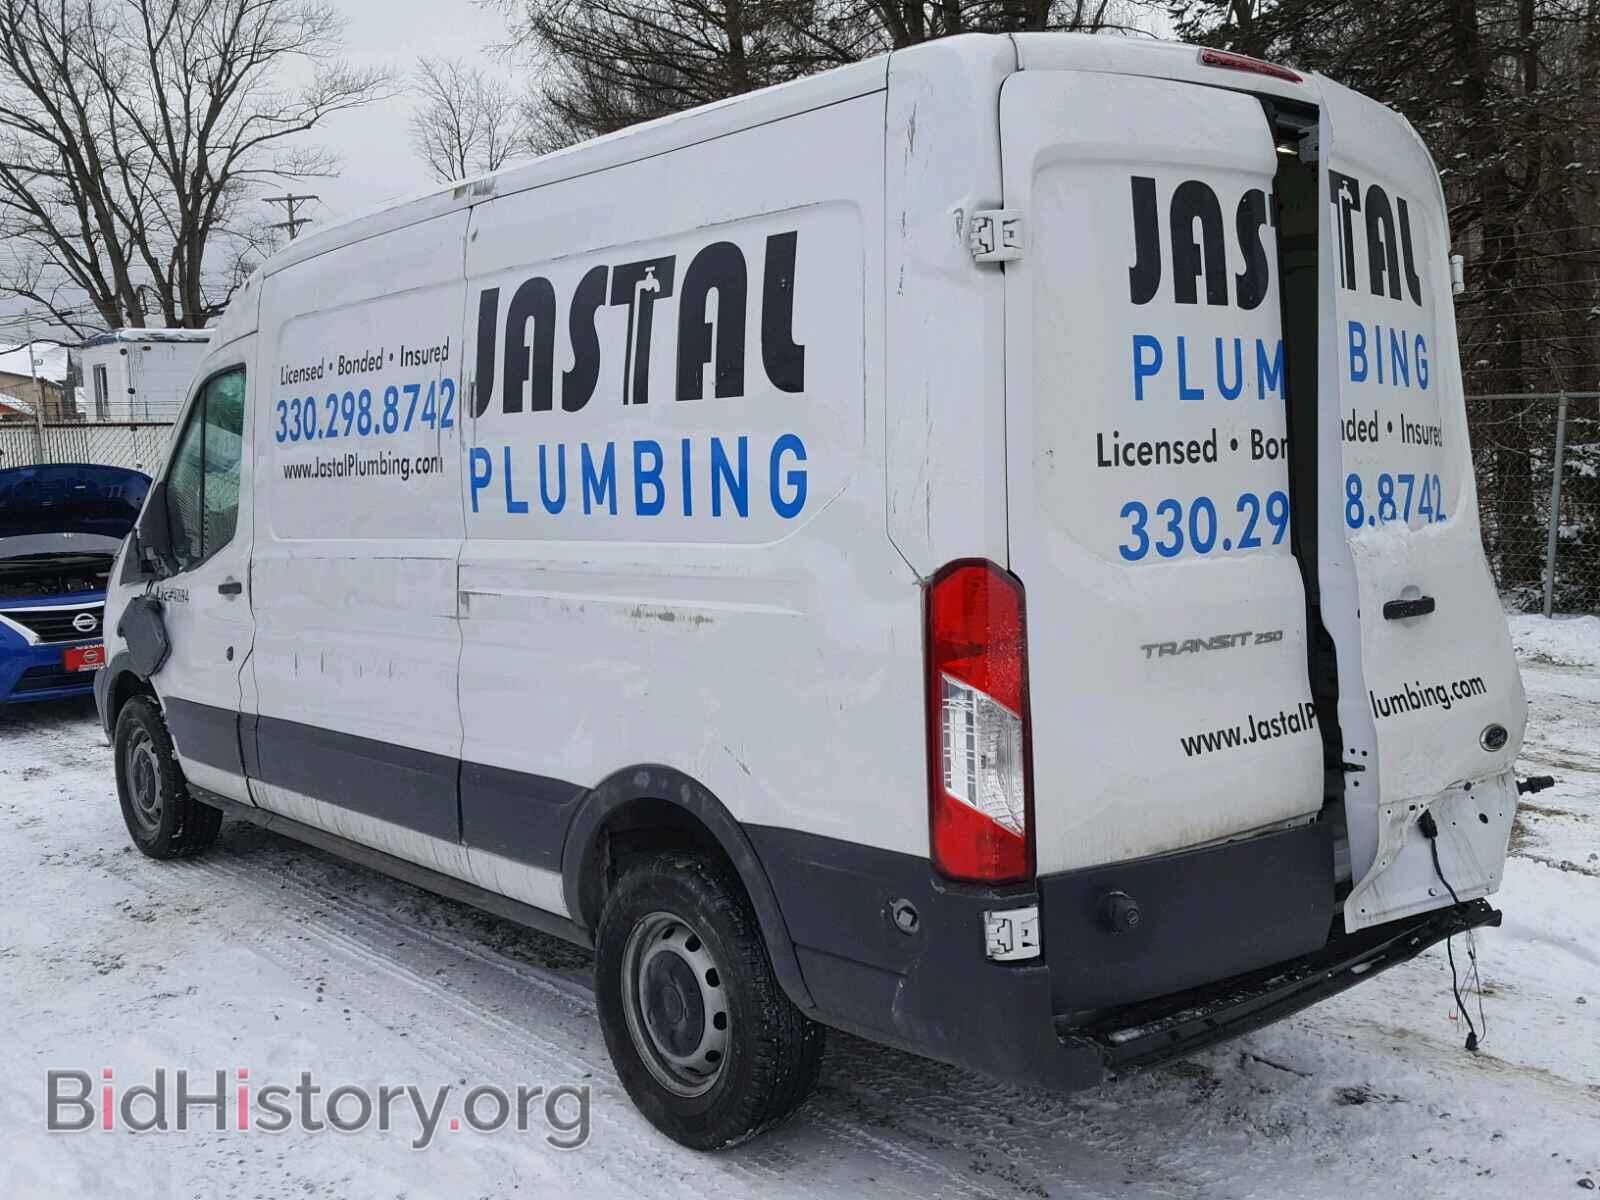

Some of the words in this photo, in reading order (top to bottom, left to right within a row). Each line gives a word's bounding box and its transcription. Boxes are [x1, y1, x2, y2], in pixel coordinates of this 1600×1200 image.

[468, 230, 806, 419] JASTAL
[280, 357, 325, 386] Licensed
[337, 347, 384, 376] Bonded
[400, 335, 450, 368] Insured
[275, 377, 456, 443] 330.298.8742
[283, 451, 443, 481] www.JastalPlumbing.com
[1096, 427, 1218, 468] Licensed
[469, 433, 808, 520] PLUMBING
[1140, 631, 1253, 660] TRANSIT
[1254, 630, 1284, 646] 250
